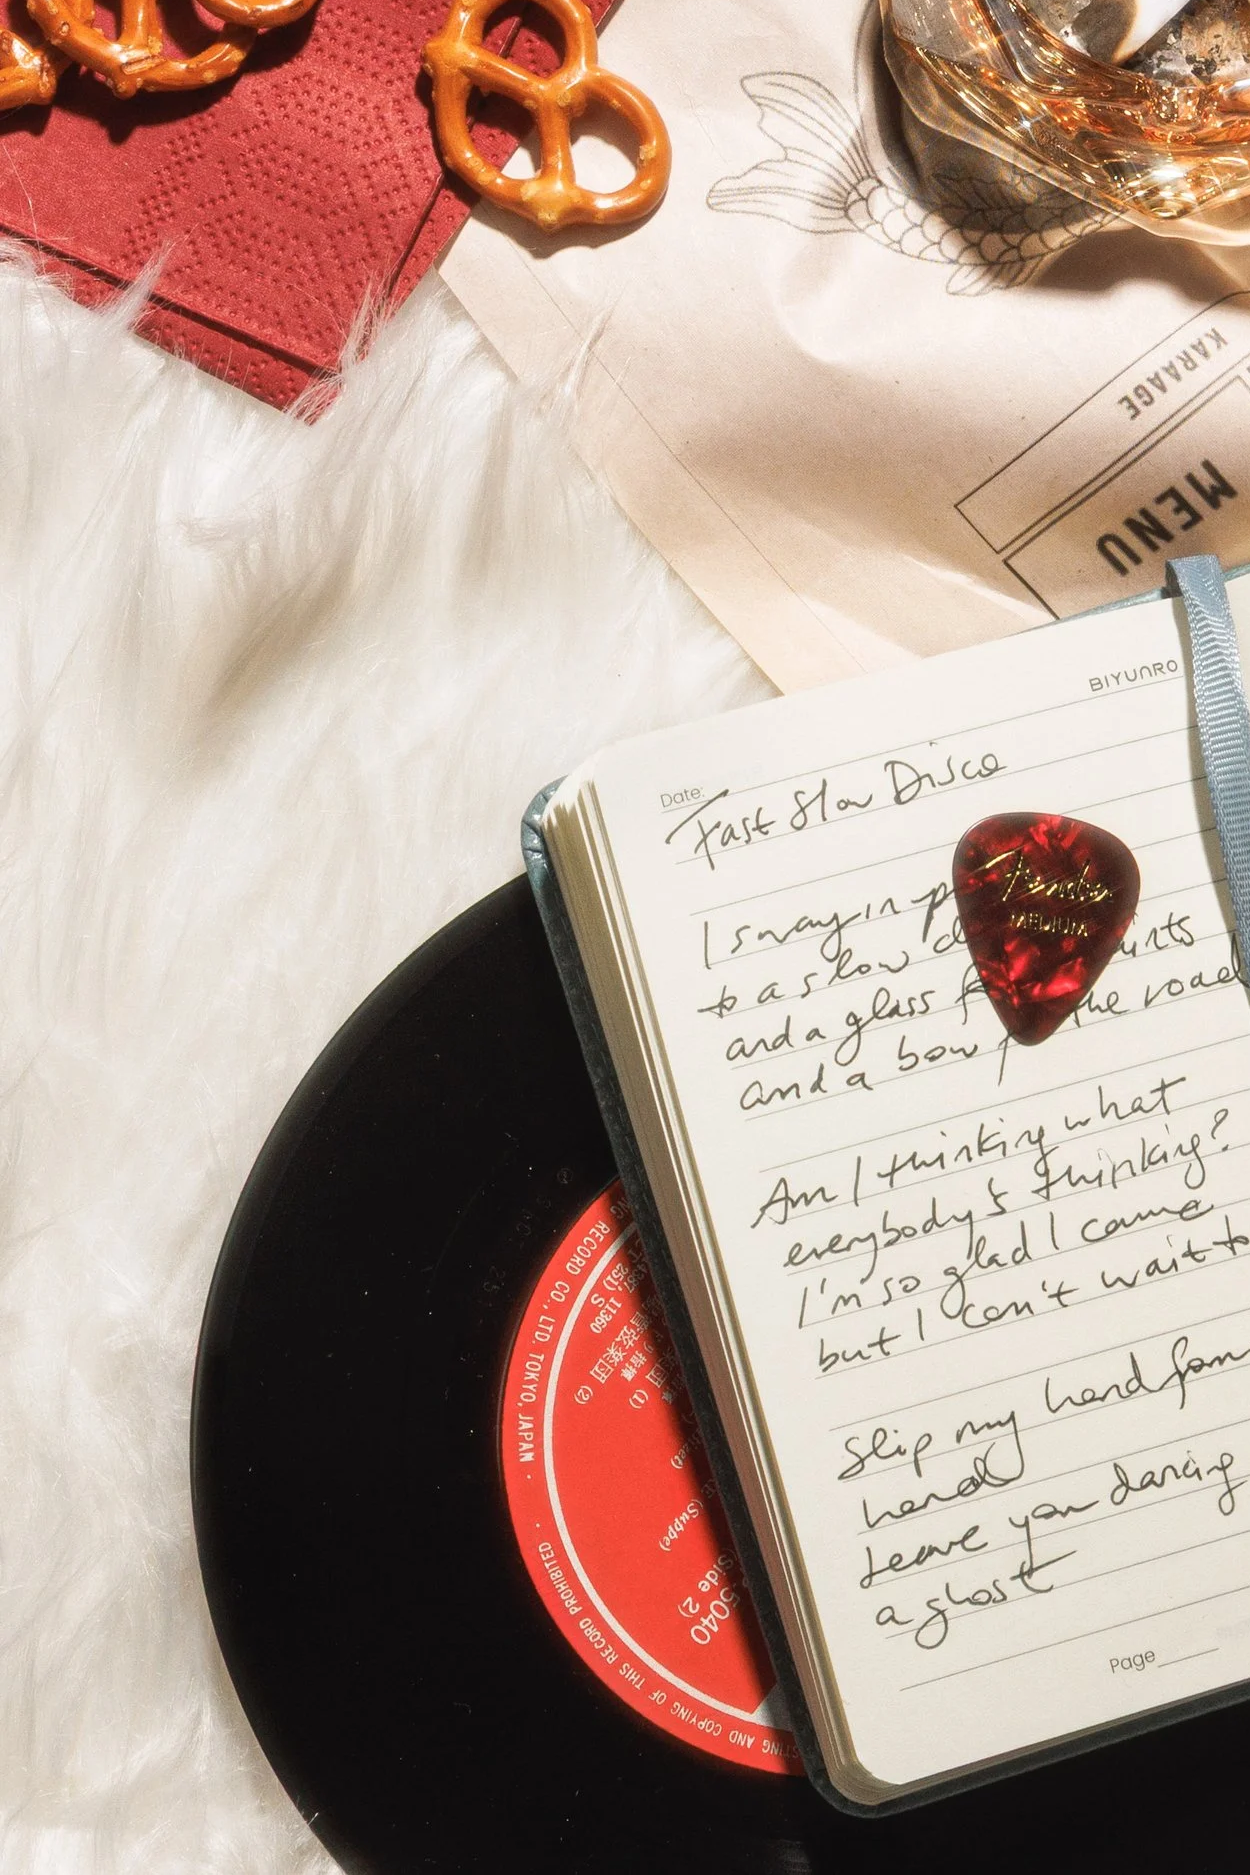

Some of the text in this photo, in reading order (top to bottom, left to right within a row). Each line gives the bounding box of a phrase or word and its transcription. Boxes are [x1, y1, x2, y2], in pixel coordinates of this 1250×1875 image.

[1116, 327, 1227, 420] KARAAGE
[1095, 459, 1237, 576] MENU
[660, 786, 705, 808] Date:
[666, 789, 776, 870] Fast
[885, 740, 1008, 806] Disco
[1145, 934, 1249, 998] road
[835, 990, 931, 1066] glass
[751, 1178, 839, 1229] Am
[1066, 1075, 1187, 1131] what
[565, 1219, 610, 1275] RECORD
[1081, 1199, 1215, 1245] came
[962, 1234, 1212, 1329] can't wait
[531, 1317, 555, 1344] LTD.
[516, 1352, 544, 1407] TOKYO,
[573, 1385, 592, 1405] (2)
[518, 1415, 534, 1462] JAPAN
[677, 1596, 700, 1617] 2)
[915, 1550, 1076, 1649] ghost
[538, 1541, 755, 1749] AND COPYING OF THIS RECORD PROHIBITED
[1109, 1648, 1156, 1674] Page
